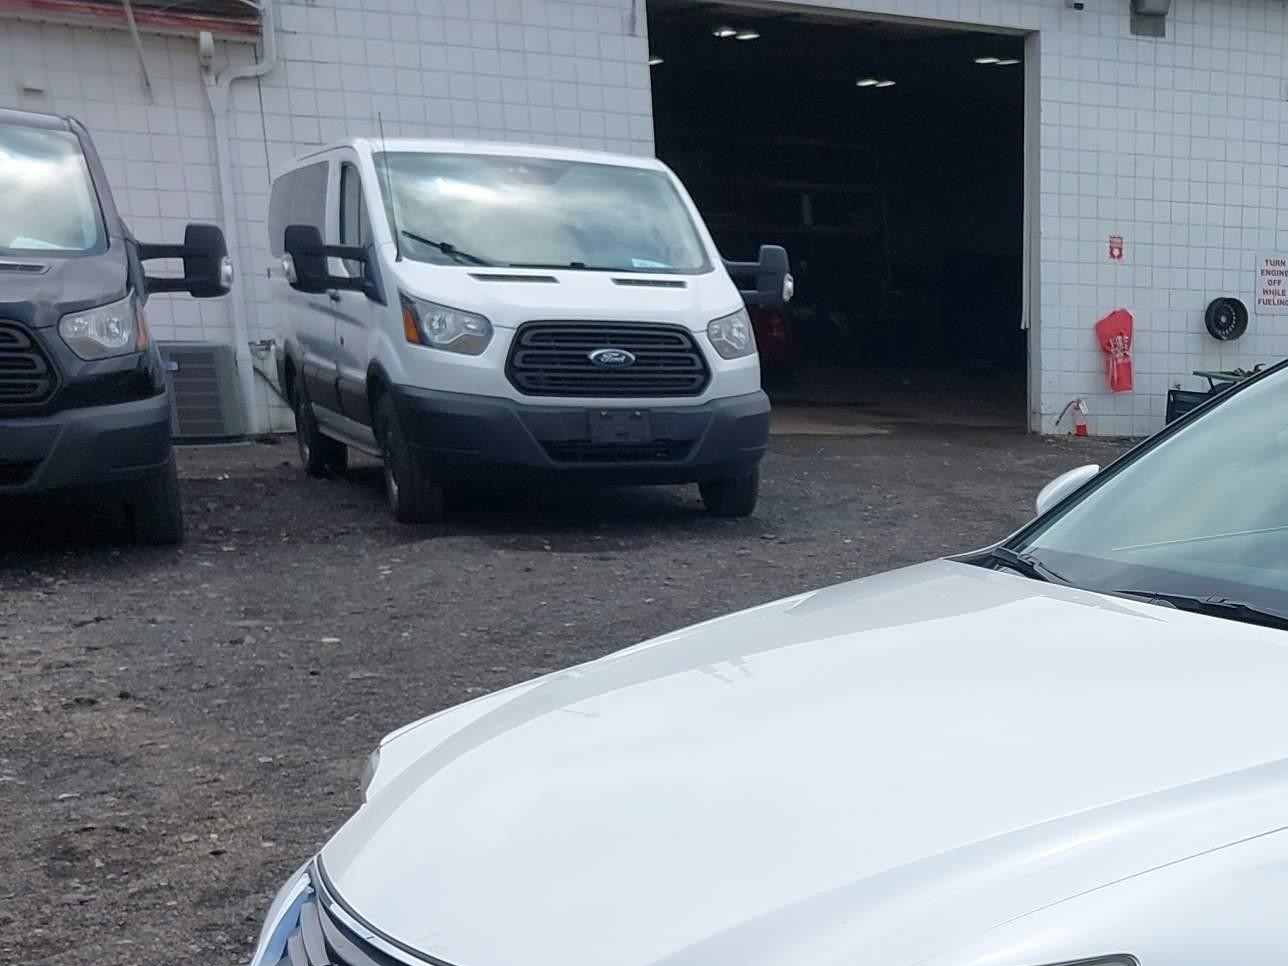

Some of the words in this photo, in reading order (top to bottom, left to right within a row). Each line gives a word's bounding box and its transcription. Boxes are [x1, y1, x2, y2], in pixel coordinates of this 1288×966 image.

[1265, 259, 1286, 267] TURN
[1260, 269, 1288, 277] ENGINE
[1262, 289, 1286, 297] WHILE
